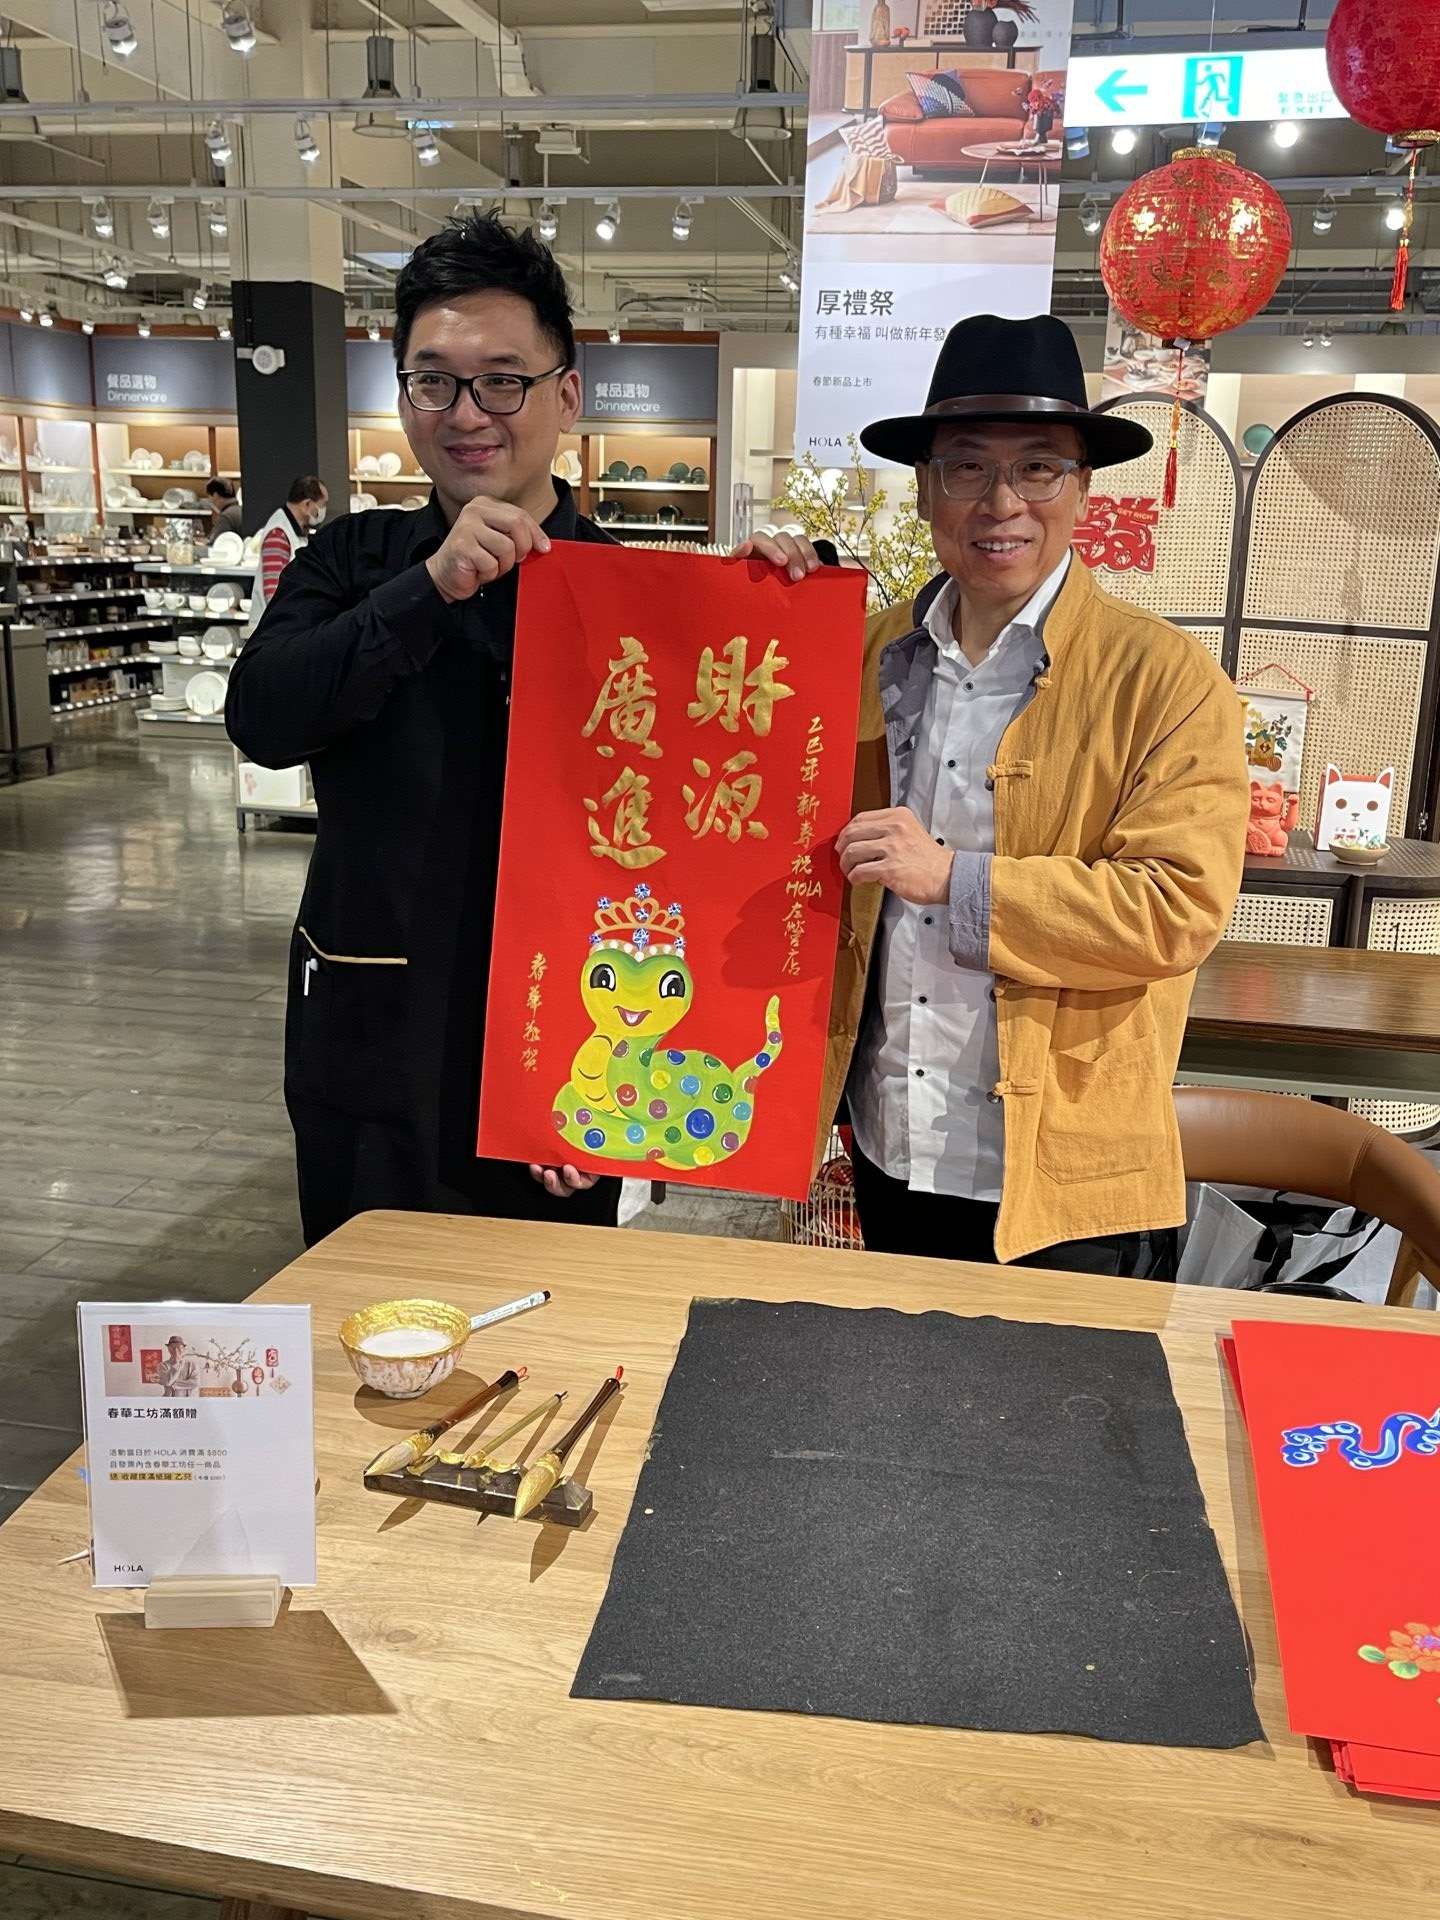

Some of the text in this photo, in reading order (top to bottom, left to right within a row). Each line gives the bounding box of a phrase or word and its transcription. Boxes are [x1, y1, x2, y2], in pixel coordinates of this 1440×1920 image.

[816, 289, 895, 316] 厚禮祭
[815, 325, 947, 342] 有種幸福 叫做新年發
[813, 376, 872, 387] 春節新品上市
[107, 390, 167, 402] Dinnerware
[595, 400, 660, 412] Dinnerware
[809, 437, 842, 447] HOLA
[1116, 508, 1153, 520] GET RICH
[682, 636, 796, 843] 財源
[581, 637, 668, 869] 廣進
[107, 1408, 197, 1419] 春華工坊滿額贈
[113, 1564, 144, 1572] HOLA
